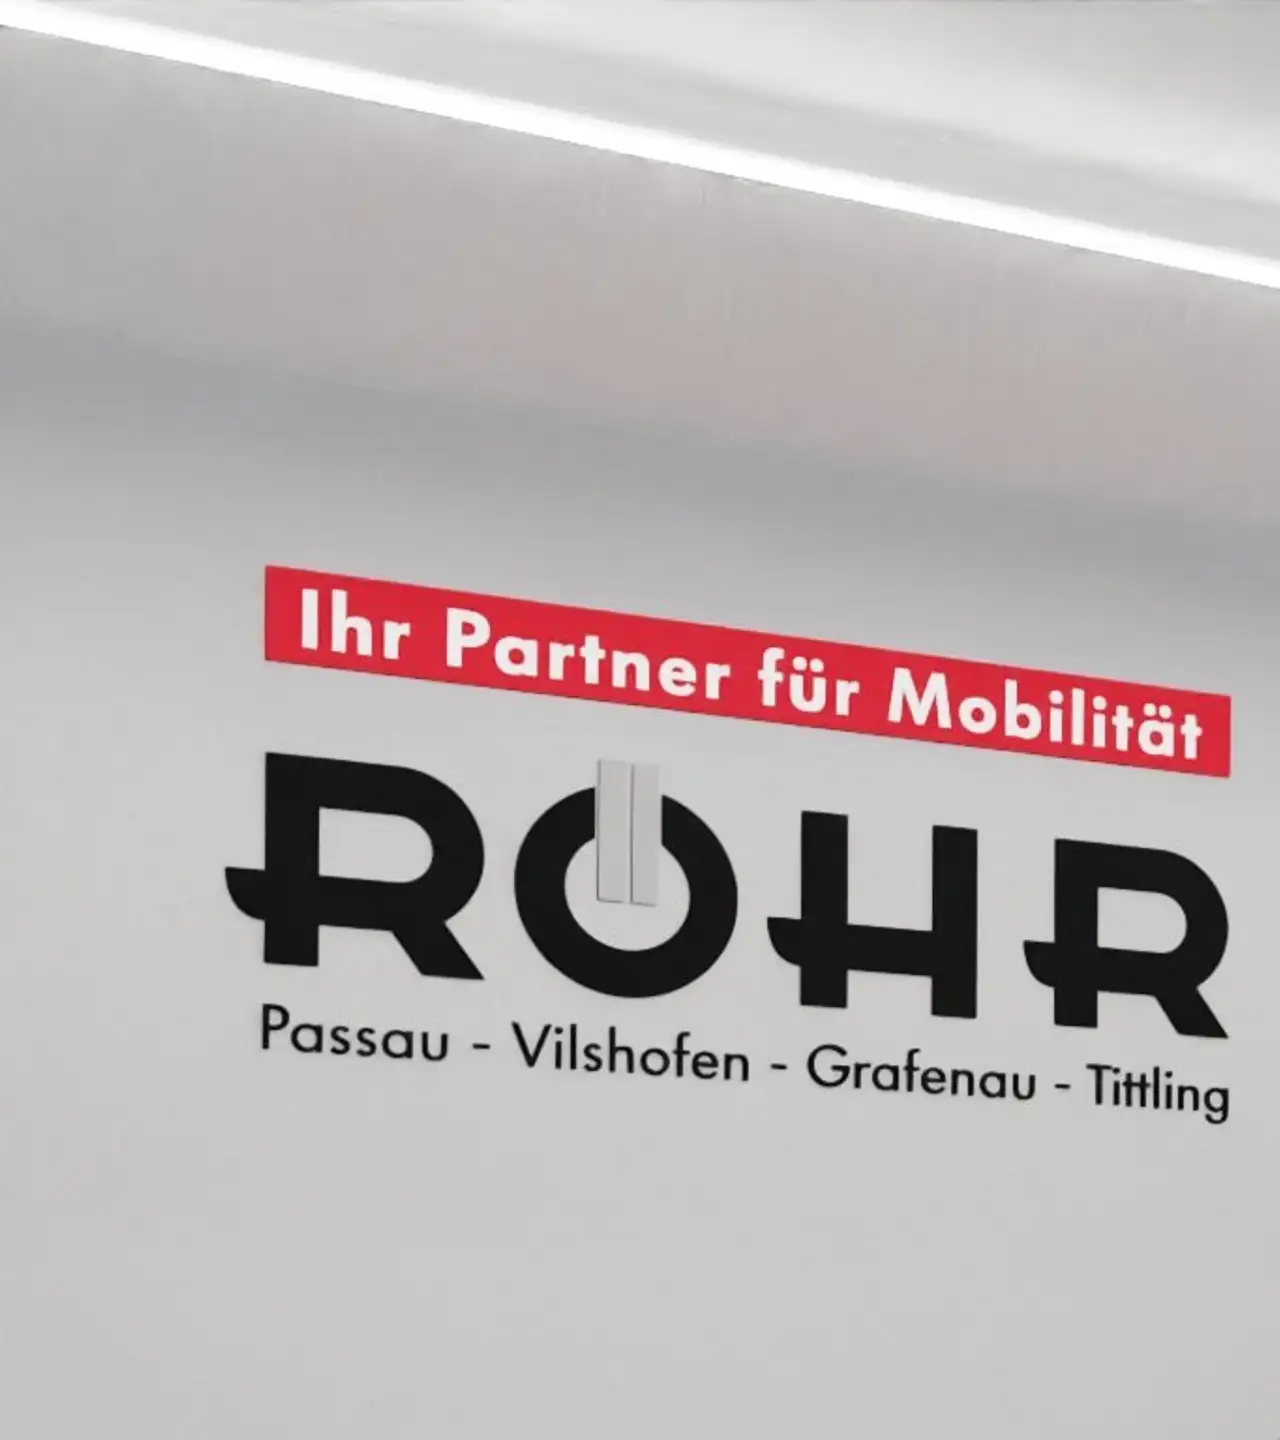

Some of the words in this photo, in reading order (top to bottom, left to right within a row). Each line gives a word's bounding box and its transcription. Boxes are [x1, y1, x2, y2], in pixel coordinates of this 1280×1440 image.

[301, 588, 411, 660] Ihr
[446, 607, 731, 700] Partner
[757, 647, 860, 716] für
[888, 667, 1202, 759] Mobilität
[261, 1003, 449, 1062] Passau
[511, 1021, 750, 1082] Vilshofen
[806, 1044, 1036, 1101] Grafenau
[1085, 1063, 1230, 1125] Tittling
